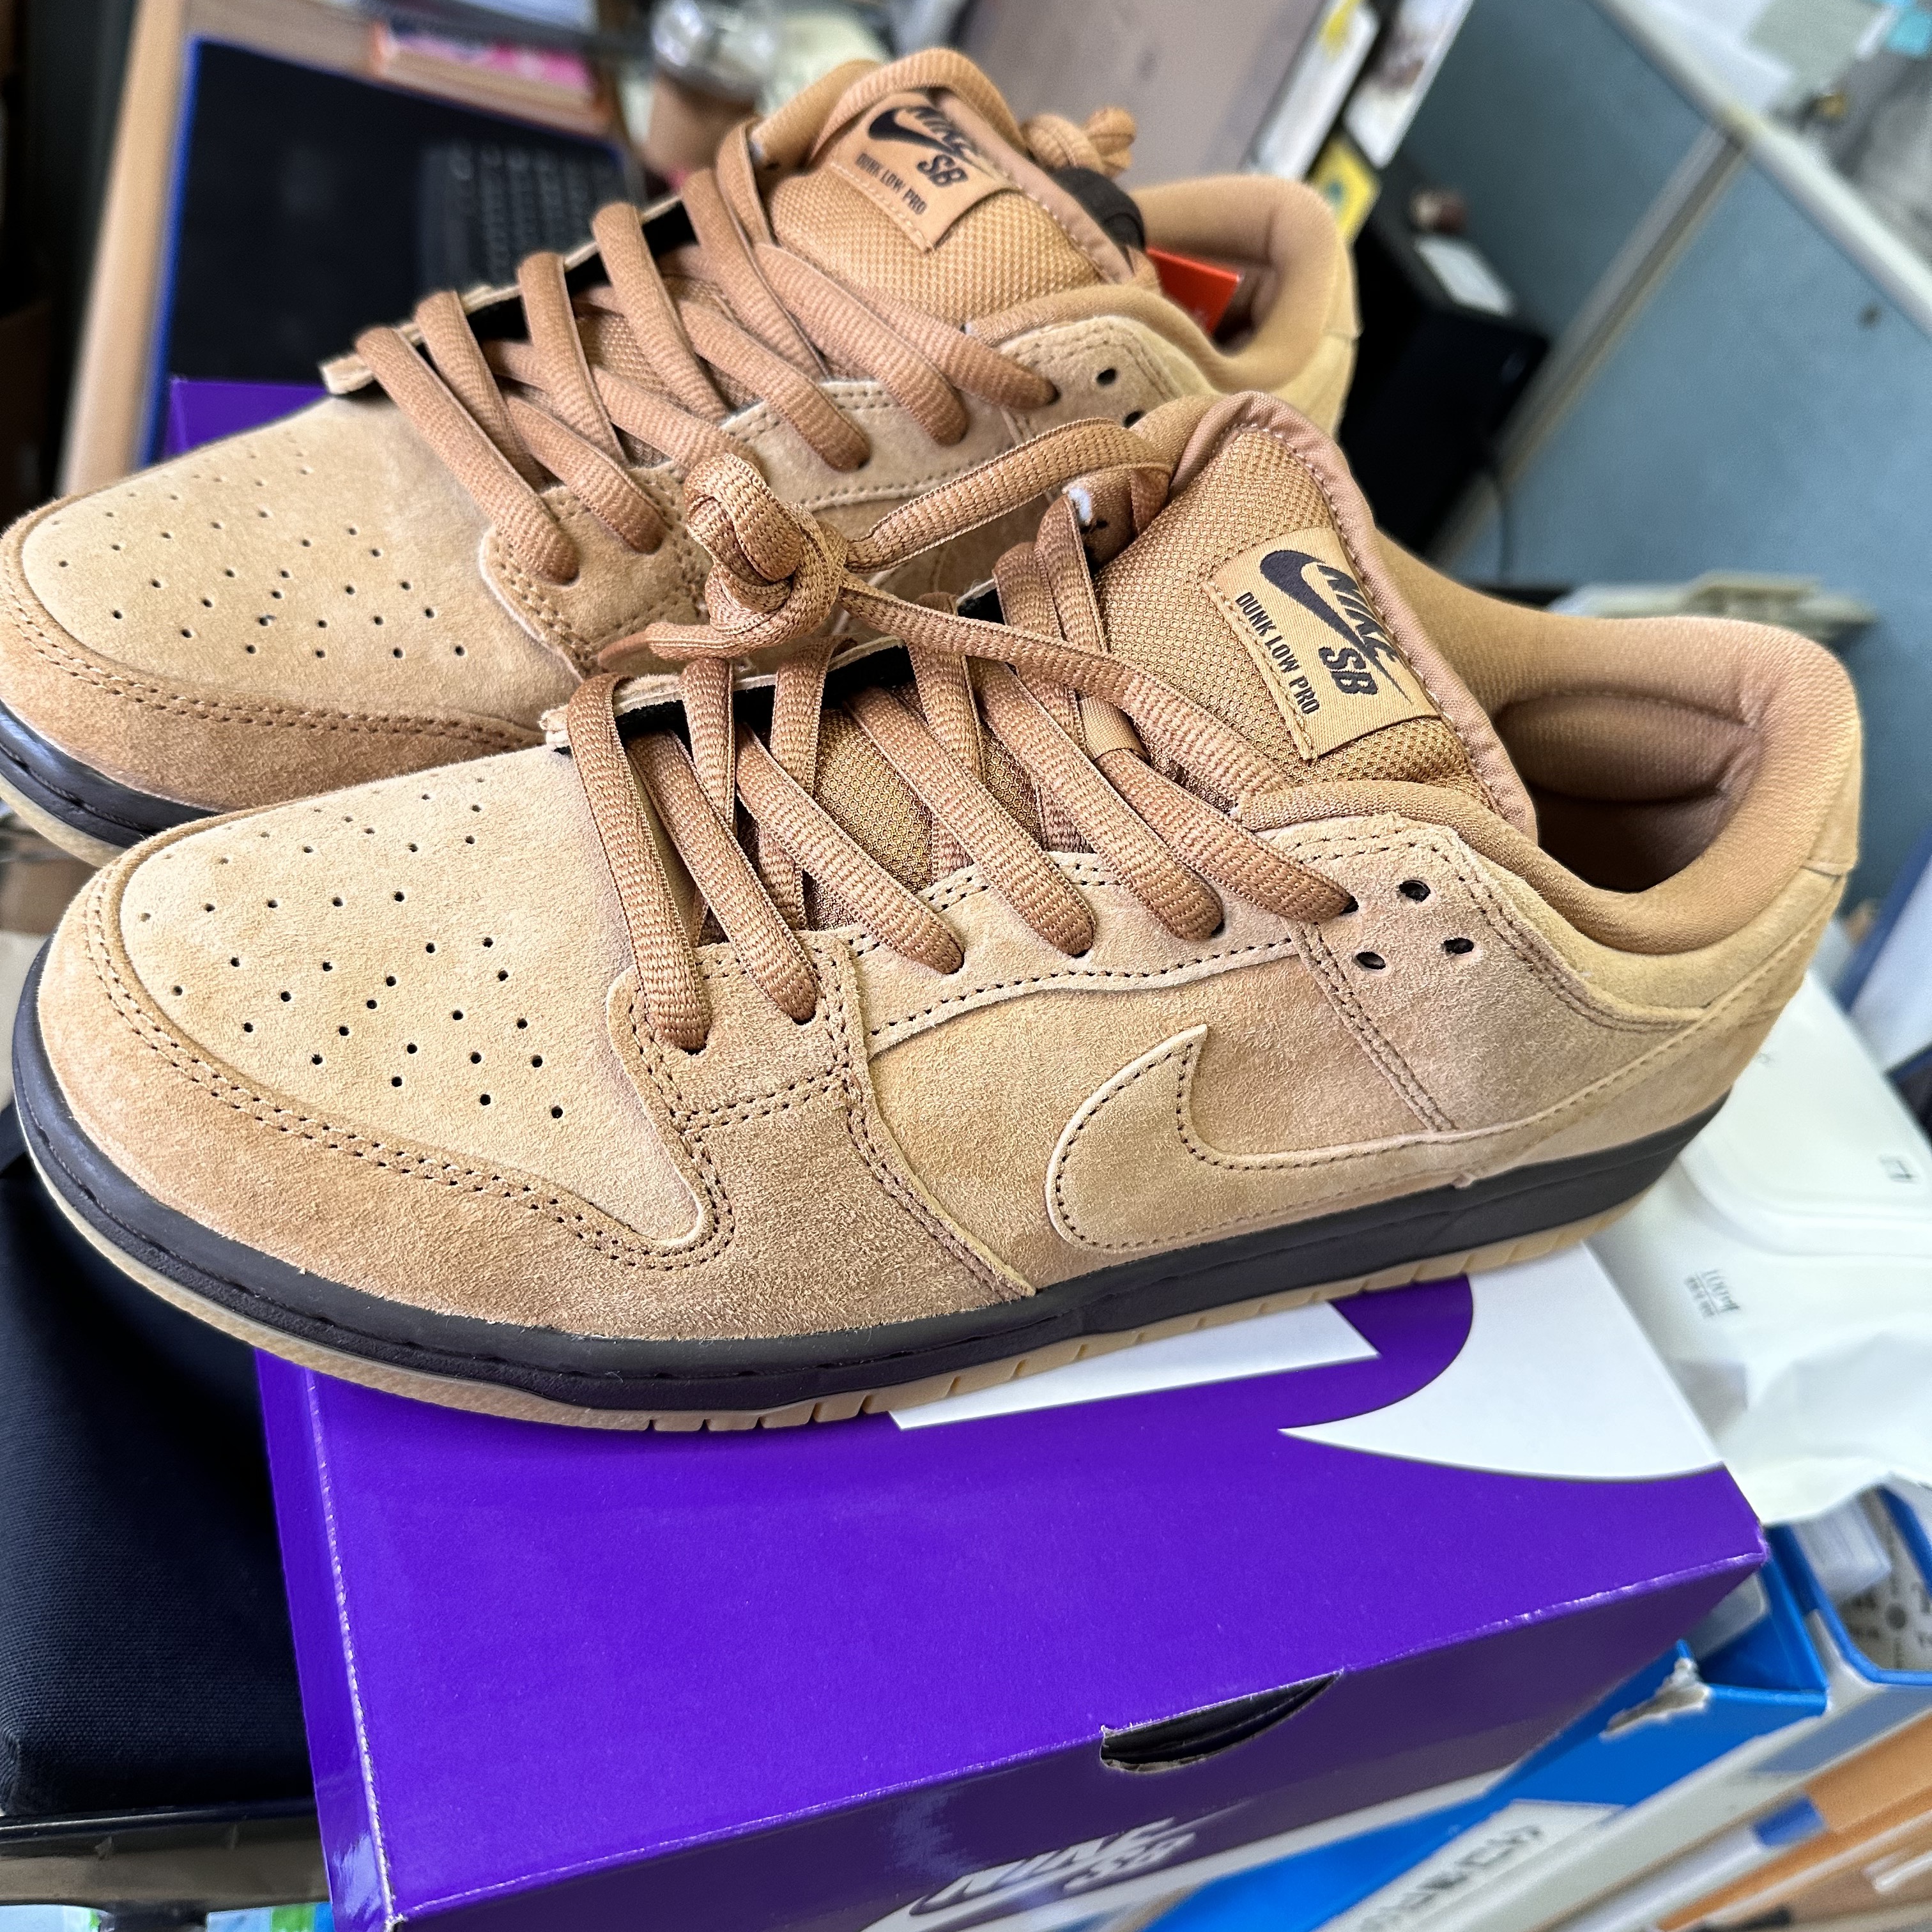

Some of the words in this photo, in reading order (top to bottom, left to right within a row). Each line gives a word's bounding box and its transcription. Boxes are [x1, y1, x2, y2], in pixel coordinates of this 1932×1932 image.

[855, 153, 882, 178] DUNK
[880, 169, 905, 193] LOW
[902, 188, 928, 215] PRO
[917, 154, 968, 187] SB
[1317, 565, 1400, 663] NIKE
[1235, 592, 1276, 636] DUNK
[1264, 635, 1300, 674] LOW
[1289, 675, 1320, 715] PRO
[1318, 647, 1378, 695] SB
[923, 1816, 1176, 1908] NIKE
